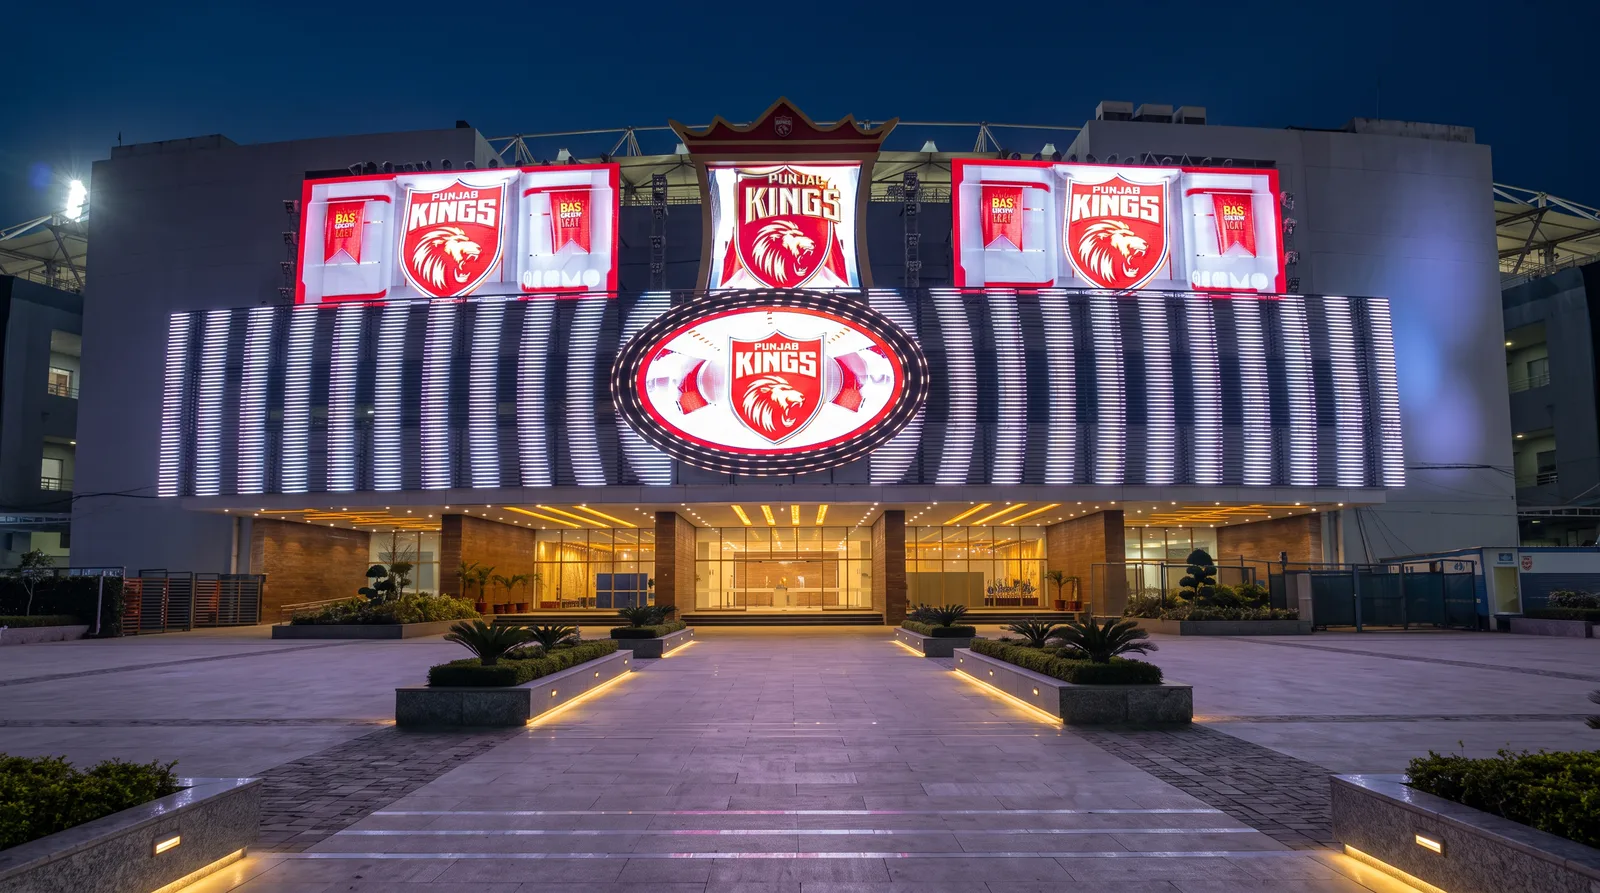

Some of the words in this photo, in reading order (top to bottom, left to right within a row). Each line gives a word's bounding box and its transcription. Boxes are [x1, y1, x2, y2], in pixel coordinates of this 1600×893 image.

[431, 190, 479, 201] PUNJAB
[1092, 185, 1141, 195] PUNJAB
[560, 202, 582, 213] BAS
[745, 186, 842, 225] KINGS
[992, 197, 1013, 209] BAS
[1071, 193, 1160, 224] KINGS
[408, 198, 497, 232] KINGS
[1223, 205, 1244, 215] BAS
[335, 213, 356, 224] BAS
[754, 342, 800, 351] PUNJAB
[735, 351, 817, 379] KINGS
